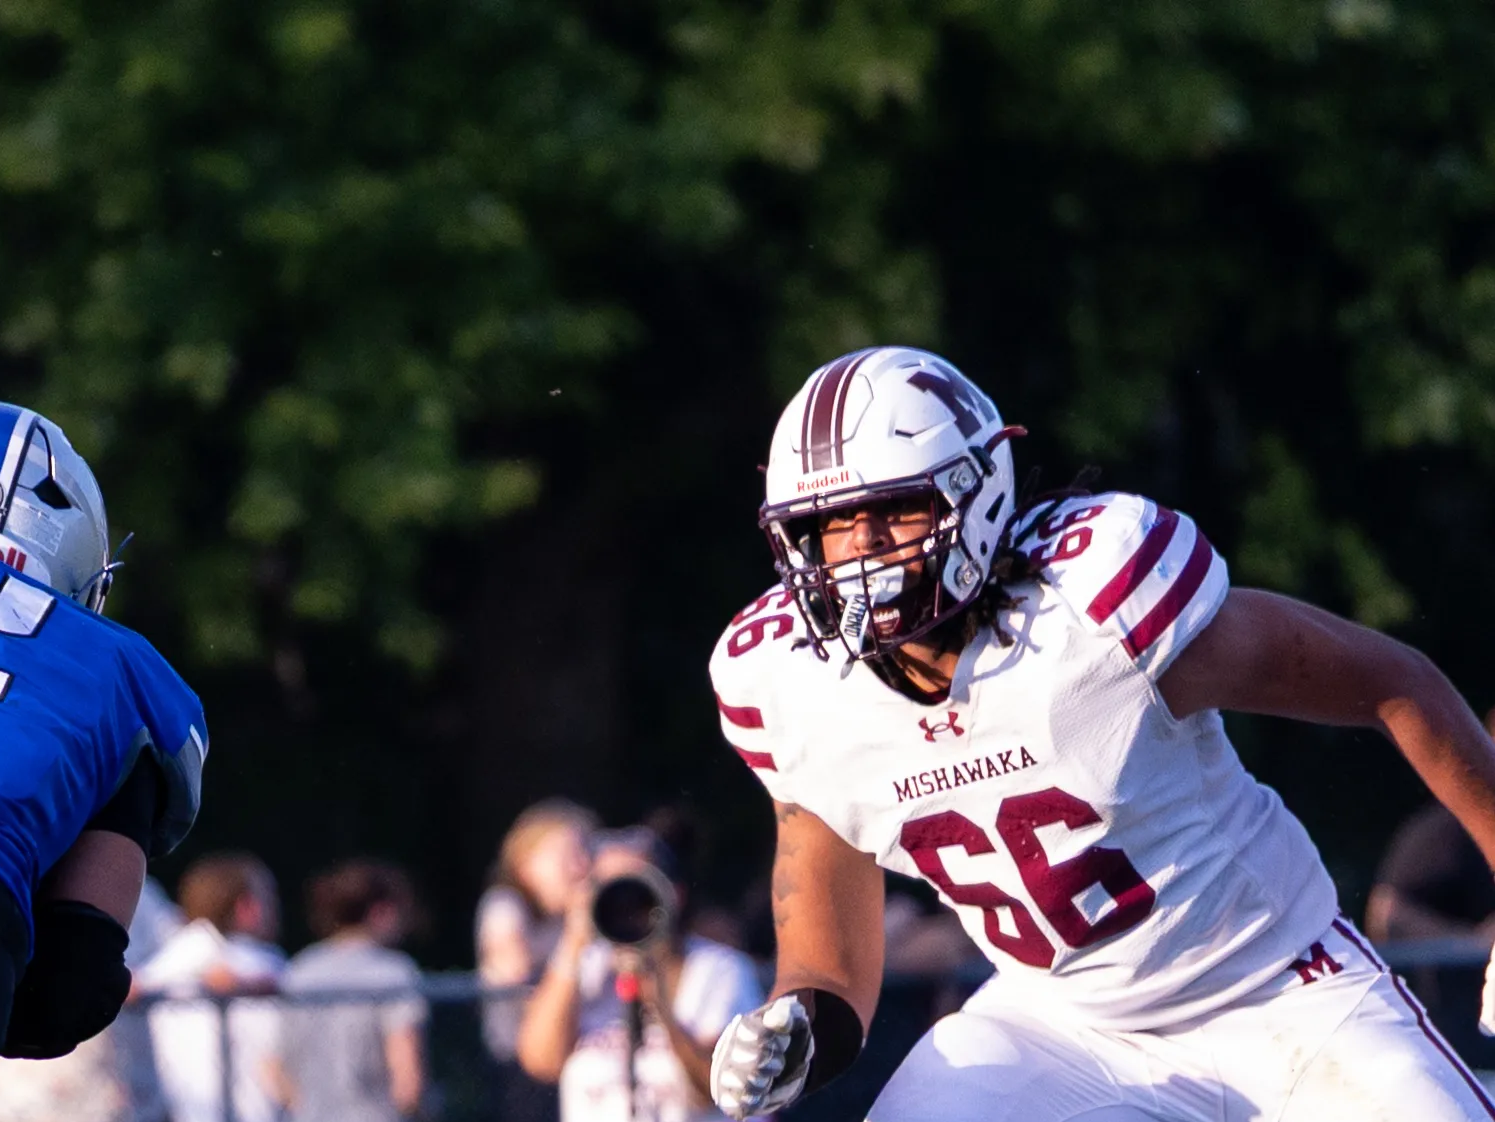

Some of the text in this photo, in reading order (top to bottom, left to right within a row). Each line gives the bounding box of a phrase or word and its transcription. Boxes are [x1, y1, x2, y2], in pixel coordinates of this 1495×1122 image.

[797, 470, 850, 493] Riddell
[893, 746, 1038, 802] MISHAWAKA
[900, 786, 1157, 970] 66
[1287, 941, 1344, 986] M
